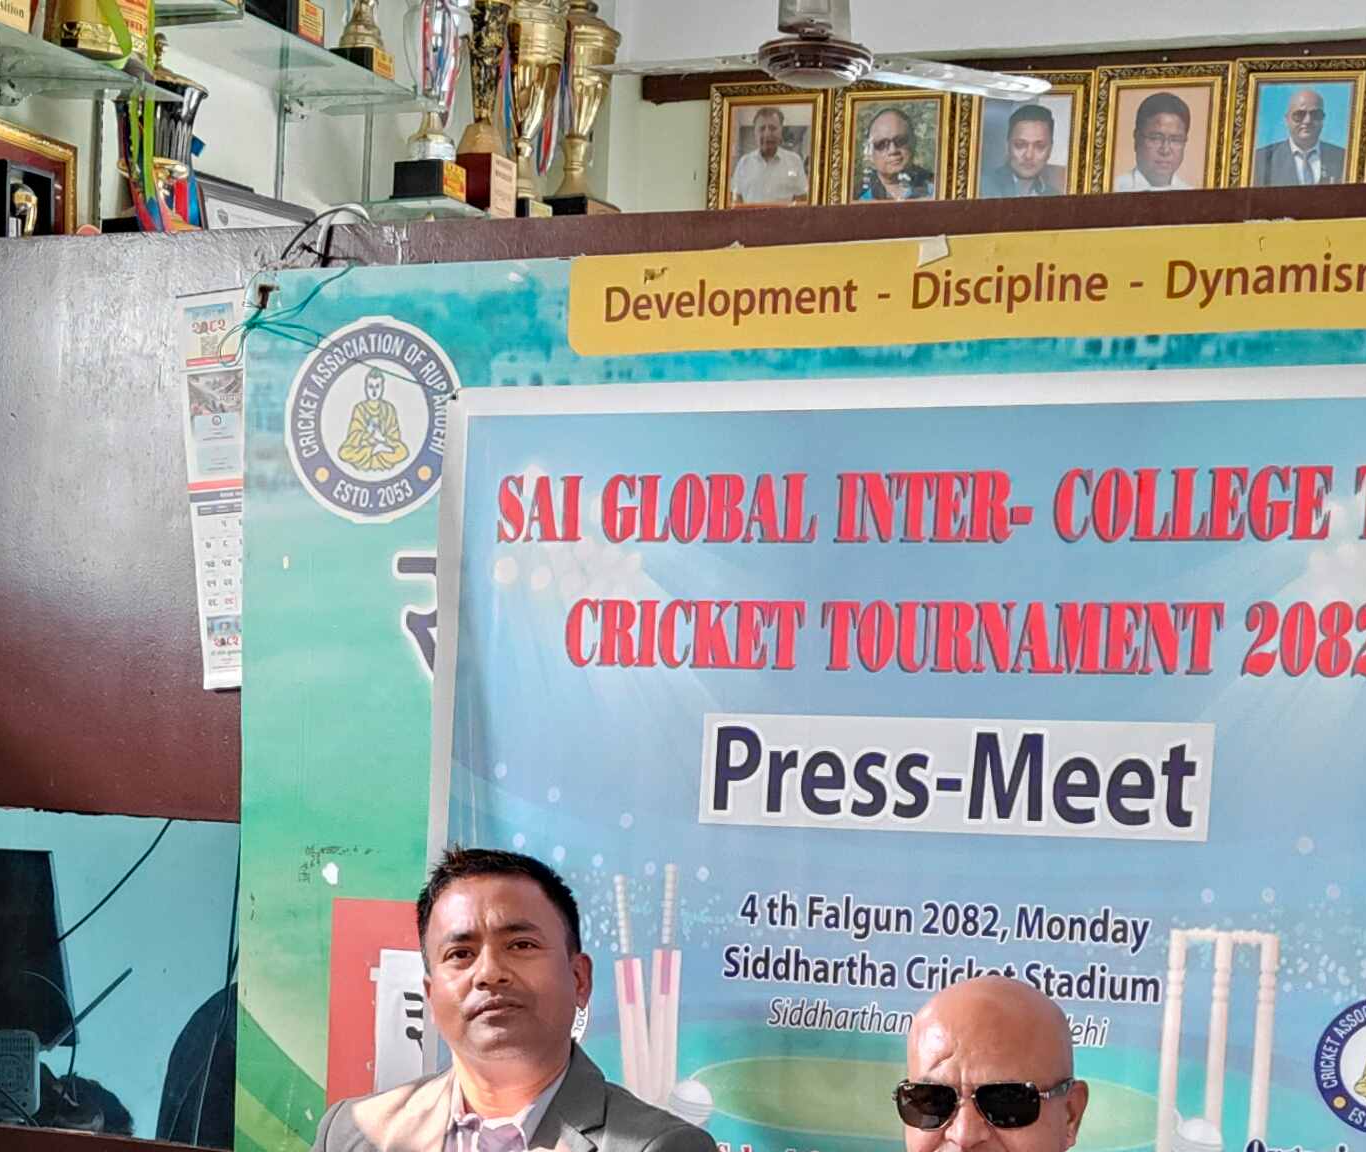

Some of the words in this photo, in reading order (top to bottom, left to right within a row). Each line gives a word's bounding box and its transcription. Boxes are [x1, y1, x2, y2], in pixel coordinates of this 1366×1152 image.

[605, 278, 858, 326] Development
[911, 263, 1108, 314] Discipline
[297, 388, 320, 458] CRICKET
[310, 333, 406, 389] ASSOCIATION
[404, 342, 427, 367] OF
[333, 479, 374, 508] ESTD.
[378, 478, 414, 507] 2053
[497, 474, 583, 543] SAI
[601, 472, 818, 543] GLOBAL
[833, 470, 1033, 543] INTER-
[1053, 465, 1333, 543] COLLEGE
[565, 598, 805, 670] CRICKET
[820, 600, 1225, 675] TOURNAMENT
[712, 725, 1197, 828] Press-Meet
[740, 893, 758, 925] 4
[767, 893, 796, 927] th
[808, 895, 912, 940] Falgun
[922, 902, 1009, 943] 2082,
[1016, 906, 1150, 954] Monday
[723, 945, 896, 988] Siddhartha
[1025, 962, 1160, 1002] Stadium
[768, 998, 914, 1033] Siddharthan
[1320, 1036, 1341, 1089] CRICKET
